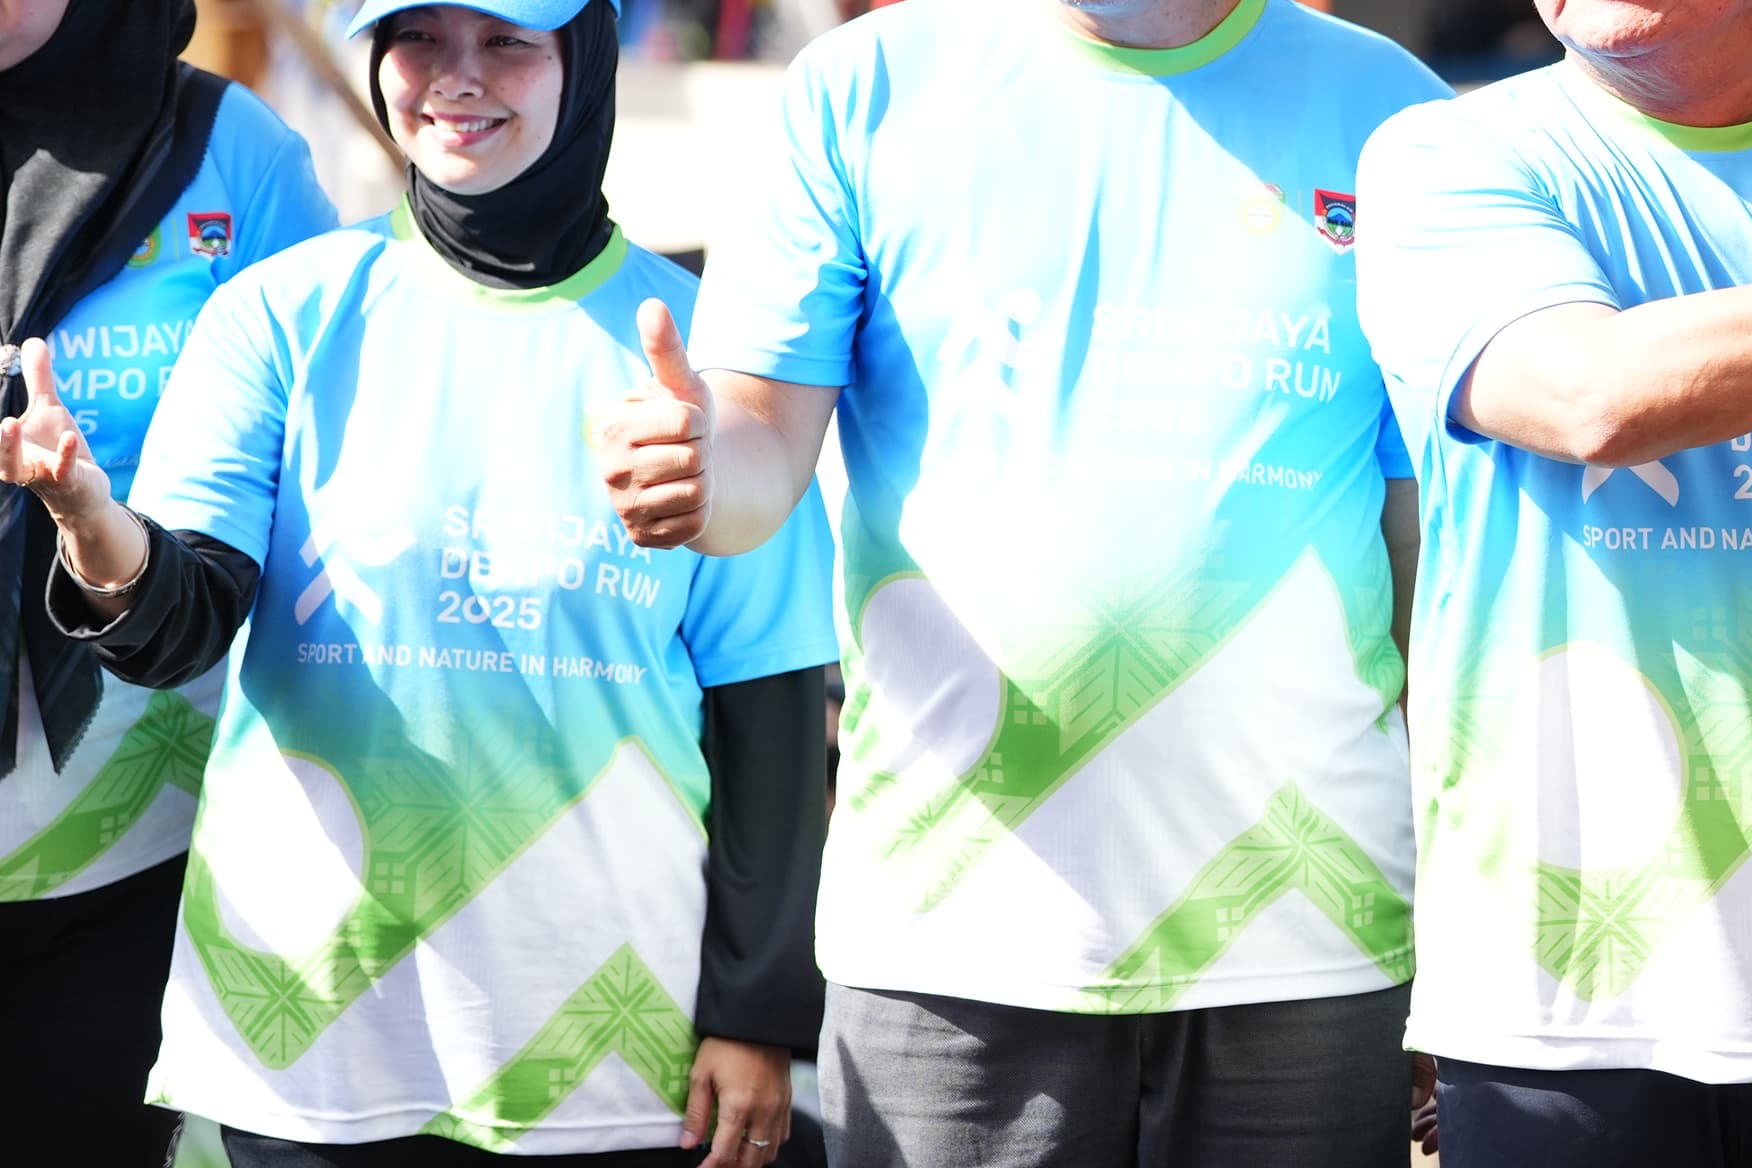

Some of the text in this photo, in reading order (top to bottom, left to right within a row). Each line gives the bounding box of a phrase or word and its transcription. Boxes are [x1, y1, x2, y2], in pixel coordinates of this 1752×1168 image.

[51, 367, 146, 401] MPO
[1264, 357, 1342, 404] RUN
[1583, 524, 1653, 551] SPORT
[1660, 527, 1716, 551] AND
[595, 562, 661, 609] RUN
[436, 589, 542, 630] 2025
[297, 642, 357, 664] SPORT
[361, 643, 411, 667] AND
[418, 645, 514, 673] NATURE
[520, 653, 545, 676] IN
